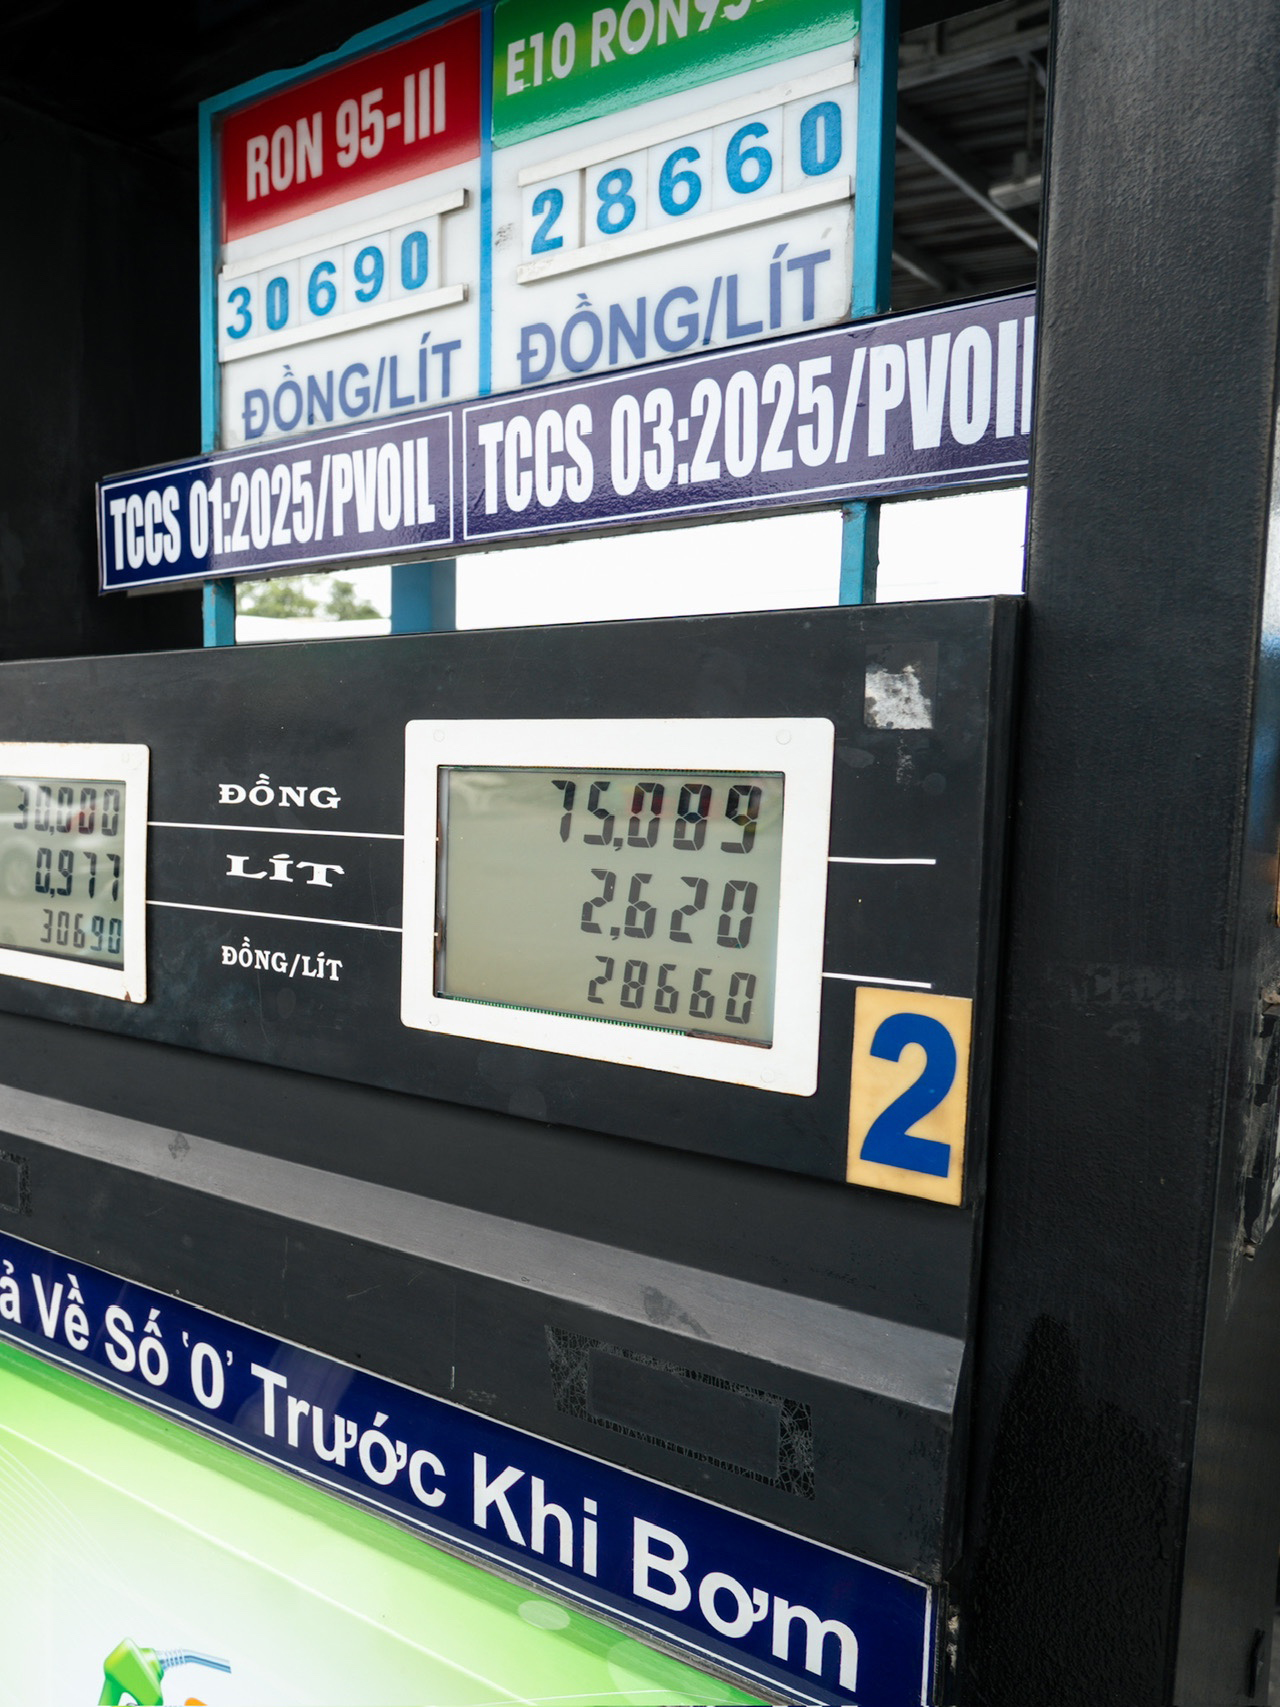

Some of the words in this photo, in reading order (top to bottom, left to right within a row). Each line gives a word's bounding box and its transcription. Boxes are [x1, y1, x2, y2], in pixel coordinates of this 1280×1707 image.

[506, 22, 576, 96] E10
[246, 115, 323, 201] RON
[336, 62, 448, 168] 95-III
[531, 100, 843, 255] 28660
[226, 231, 430, 340] 30690
[517, 243, 831, 385] ĐỒNG/LÍT
[242, 333, 462, 440] ĐỒNG/LÍT
[479, 404, 594, 517] TCCS
[109, 485, 182, 571] TCCS
[188, 437, 436, 560] 01:2025/PVOIL
[14, 785, 120, 837] 30,000
[219, 773, 341, 809] ĐỒNG
[551, 780, 763, 855] 75,089
[35, 847, 121, 902] 0,977
[226, 853, 345, 887] LÍT
[580, 868, 759, 949] 2,620
[40, 908, 122, 954] 30690
[221, 936, 343, 982] ĐỒNG/LÍT
[586, 955, 758, 1025] 28660
[860, 1012, 958, 1178] 2
[32, 1274, 91, 1352] Về
[104, 1308, 170, 1387] Số
[251, 1362, 447, 1509] Trước
[473, 1451, 599, 1578] Khi
[632, 1514, 860, 1693] Bơm
